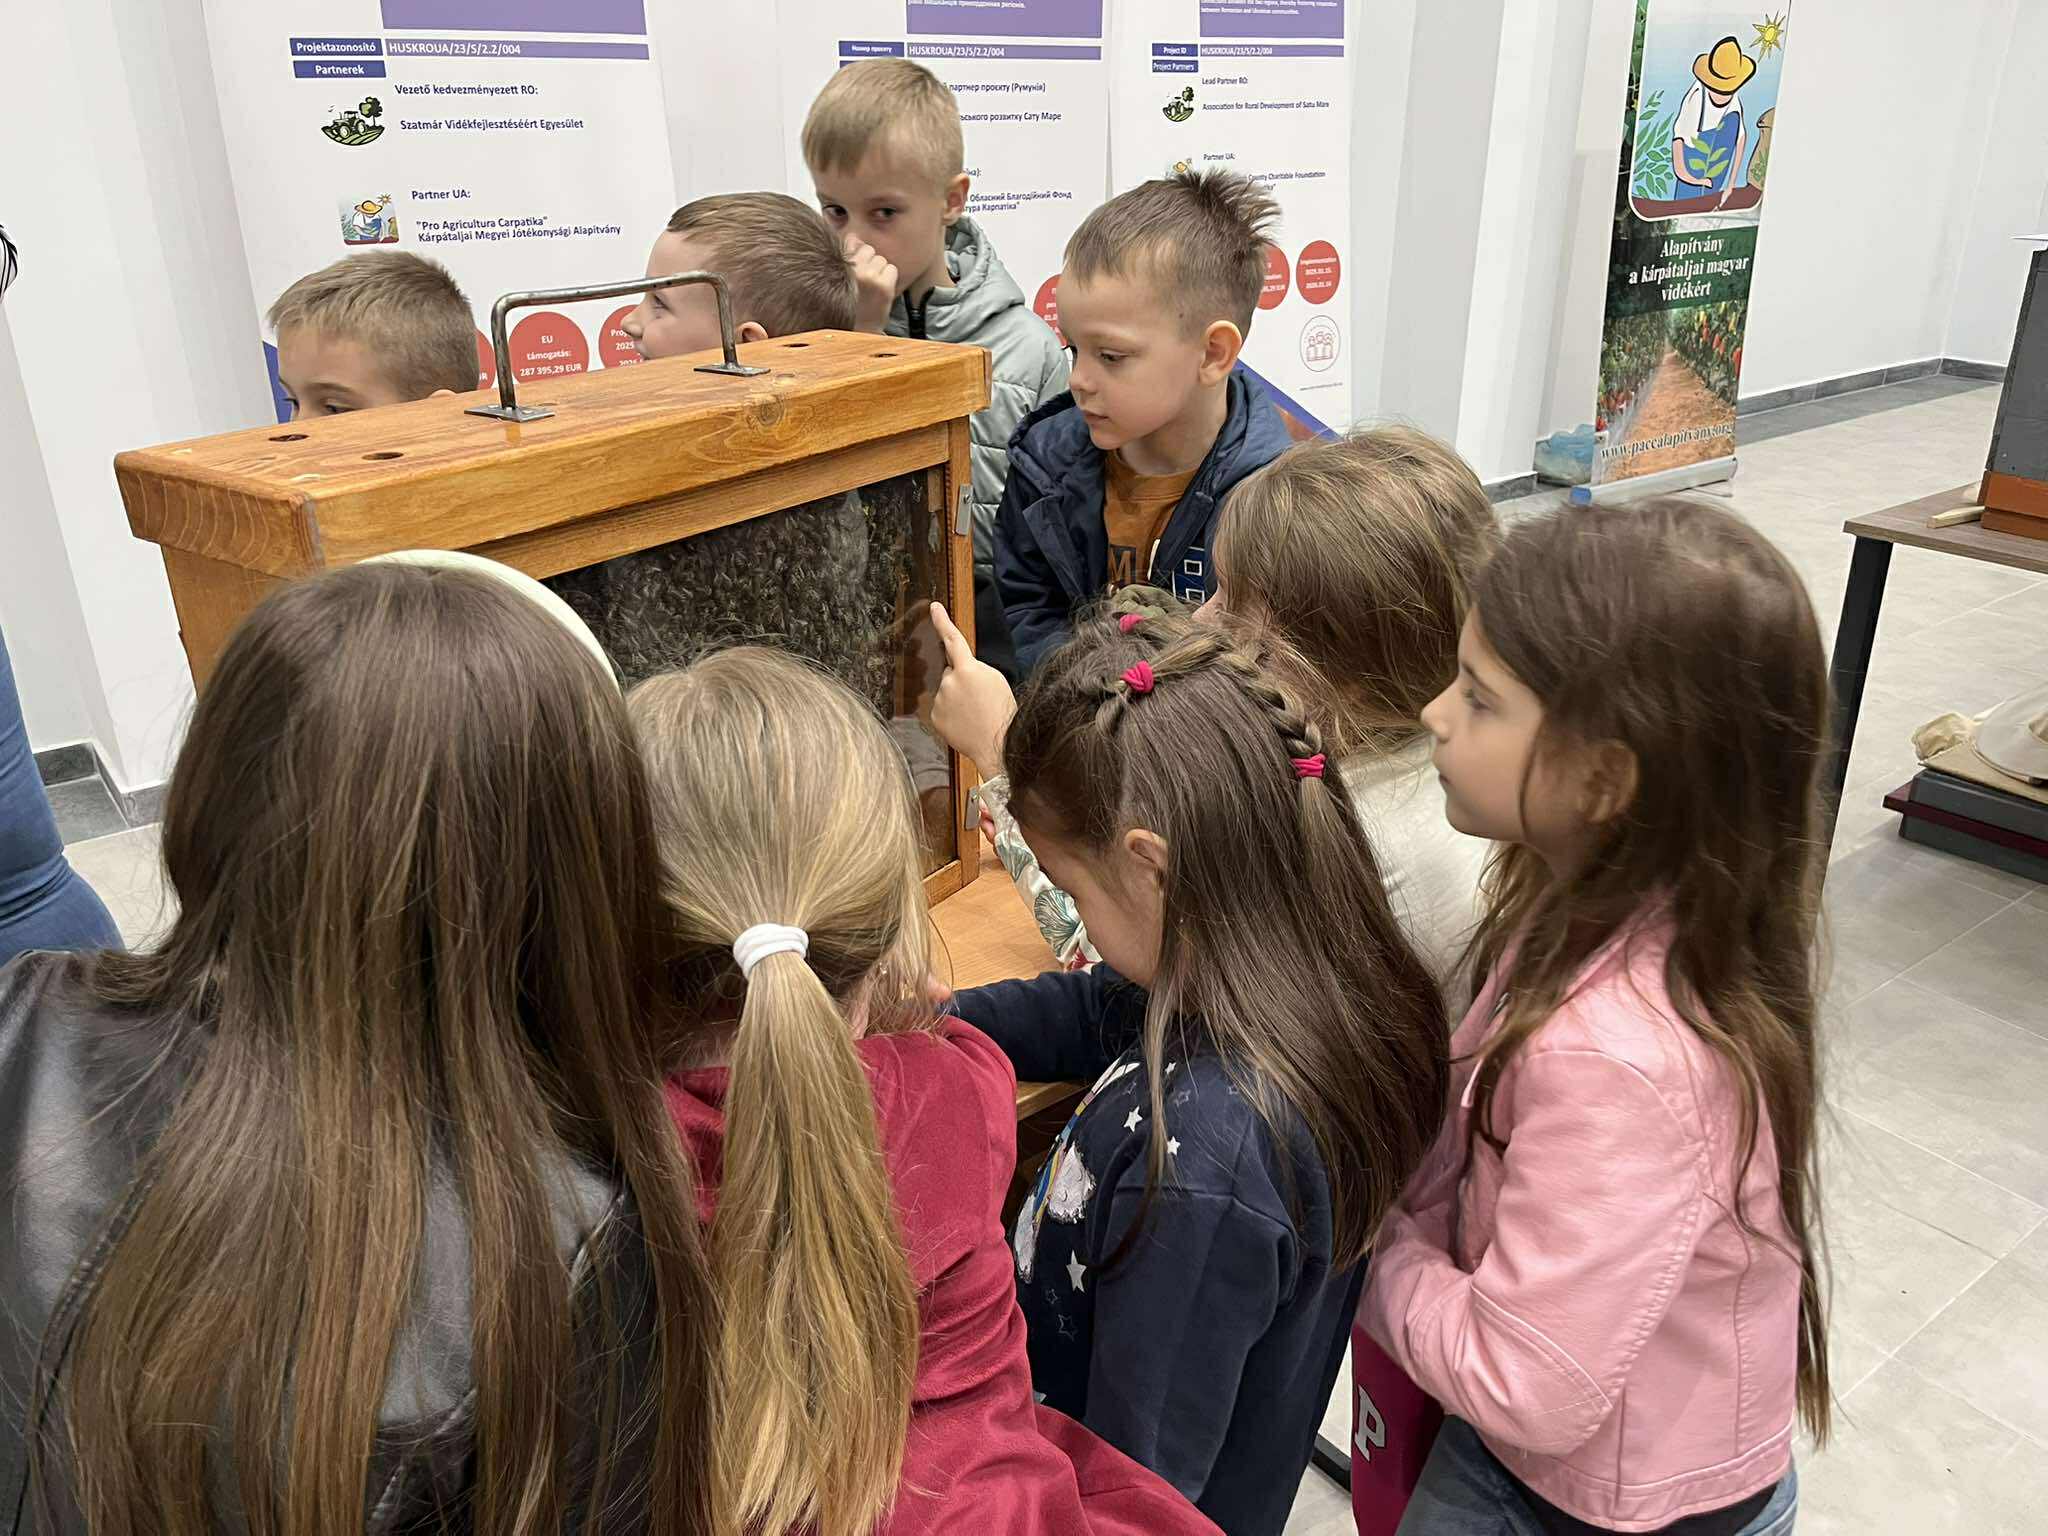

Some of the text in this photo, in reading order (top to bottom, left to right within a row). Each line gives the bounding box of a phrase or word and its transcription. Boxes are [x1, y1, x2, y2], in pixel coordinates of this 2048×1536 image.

[296, 41, 377, 54] Projektazonosító
[315, 64, 365, 75] Partnerek
[1153, 62, 1195, 72] Project Partners
[1202, 77, 1216, 85] Lead
[1217, 77, 1238, 85] Partner
[395, 84, 539, 97] Vezető kedvezményezett RO:
[1202, 103, 1234, 111] Association
[1235, 102, 1244, 110] for
[1260, 102, 1295, 110] Development
[401, 119, 442, 130] Szatmár
[540, 119, 584, 131] Egyesület
[1203, 153, 1224, 161] Partner
[1295, 171, 1326, 179] Foundation
[411, 189, 471, 200] Partner UA:
[442, 219, 496, 232] Agricultura
[418, 230, 473, 243] Kárpátaljai
[475, 229, 510, 241] Megyei
[573, 225, 621, 236] Alapítvány
[1660, 235, 1725, 259] Alapítvány
[1628, 257, 1750, 285] a kárpátaljai magyar
[1661, 281, 1713, 302] vidékért
[541, 335, 553, 344] EU
[520, 368, 535, 377] 287
[566, 363, 583, 373] EUR
